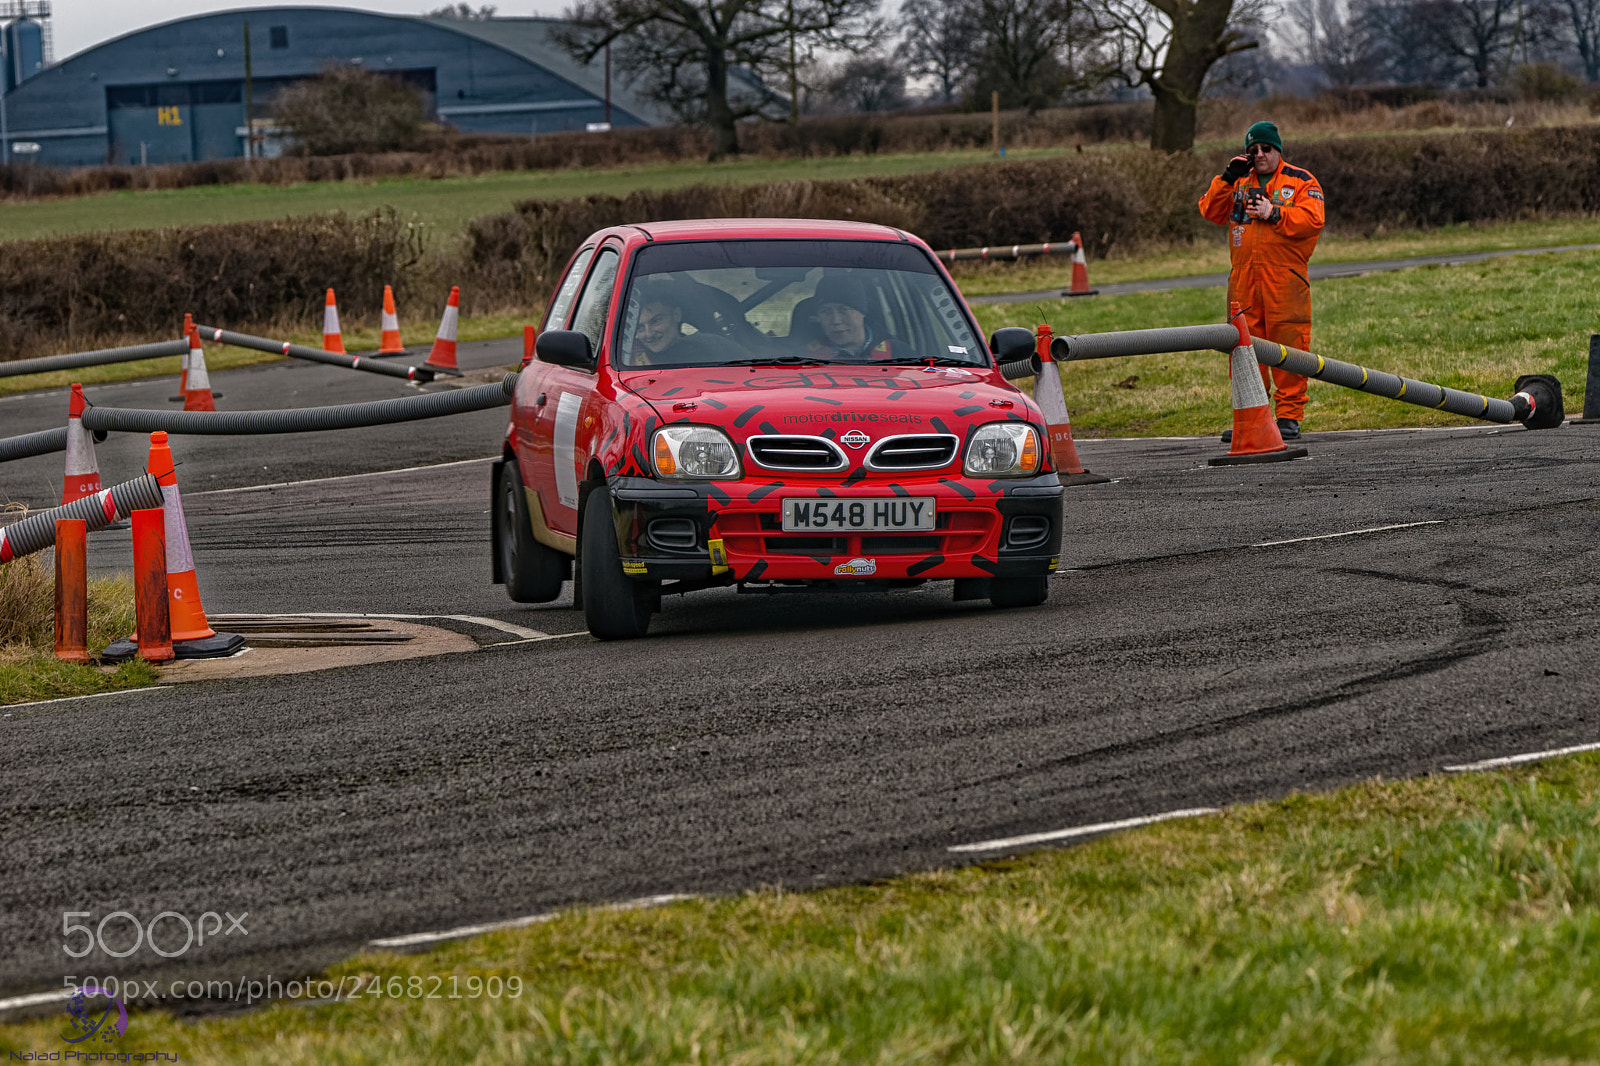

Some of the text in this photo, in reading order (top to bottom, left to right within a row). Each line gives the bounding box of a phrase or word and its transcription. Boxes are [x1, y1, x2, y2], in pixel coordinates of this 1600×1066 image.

[158, 106, 183, 125] H1
[783, 411, 922, 425] motordriveseats
[793, 501, 924, 527] M548 HUY
